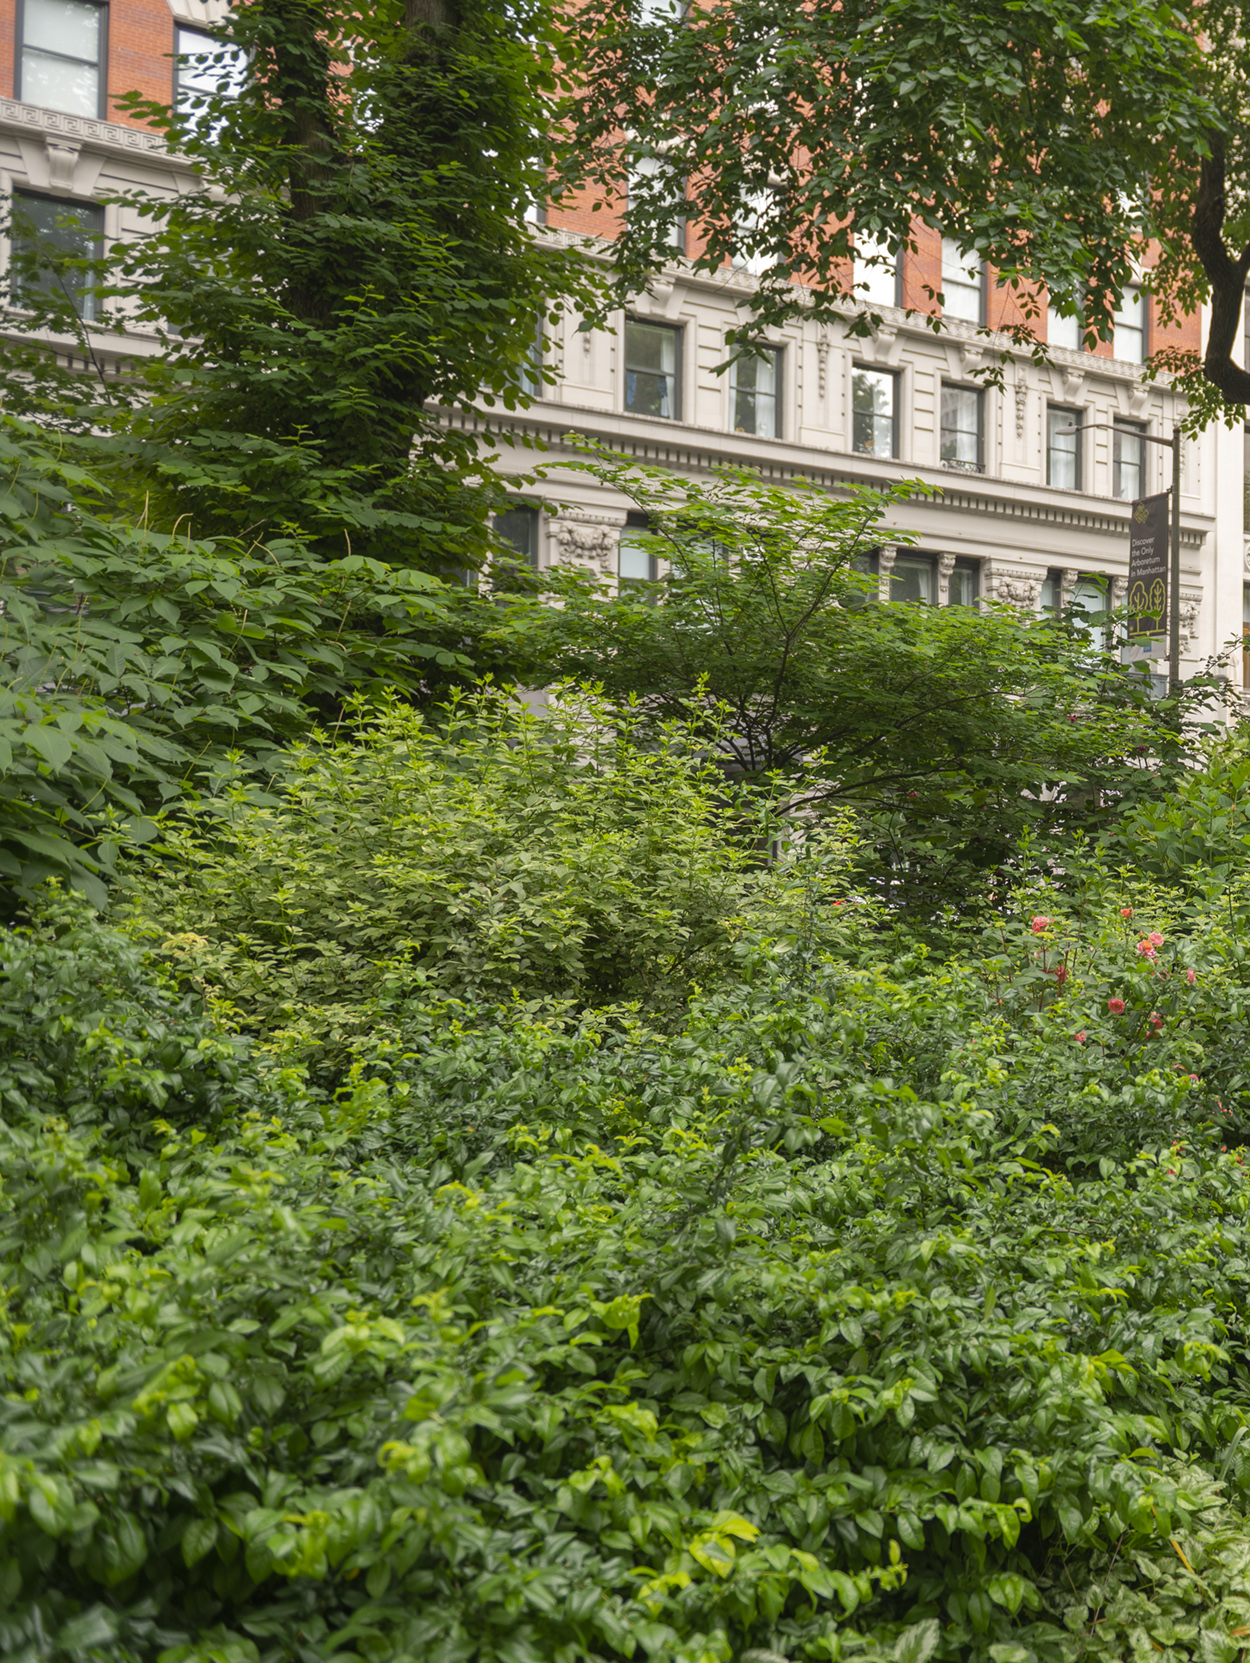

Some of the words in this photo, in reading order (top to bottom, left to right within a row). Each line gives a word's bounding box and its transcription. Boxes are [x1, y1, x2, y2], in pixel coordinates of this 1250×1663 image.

[1132, 537, 1155, 547] Discover
[1132, 549, 1140, 557] the
[1141, 546, 1154, 556] Only
[1131, 557, 1160, 567] Arboretum
[1137, 566, 1166, 576] Manhattan
